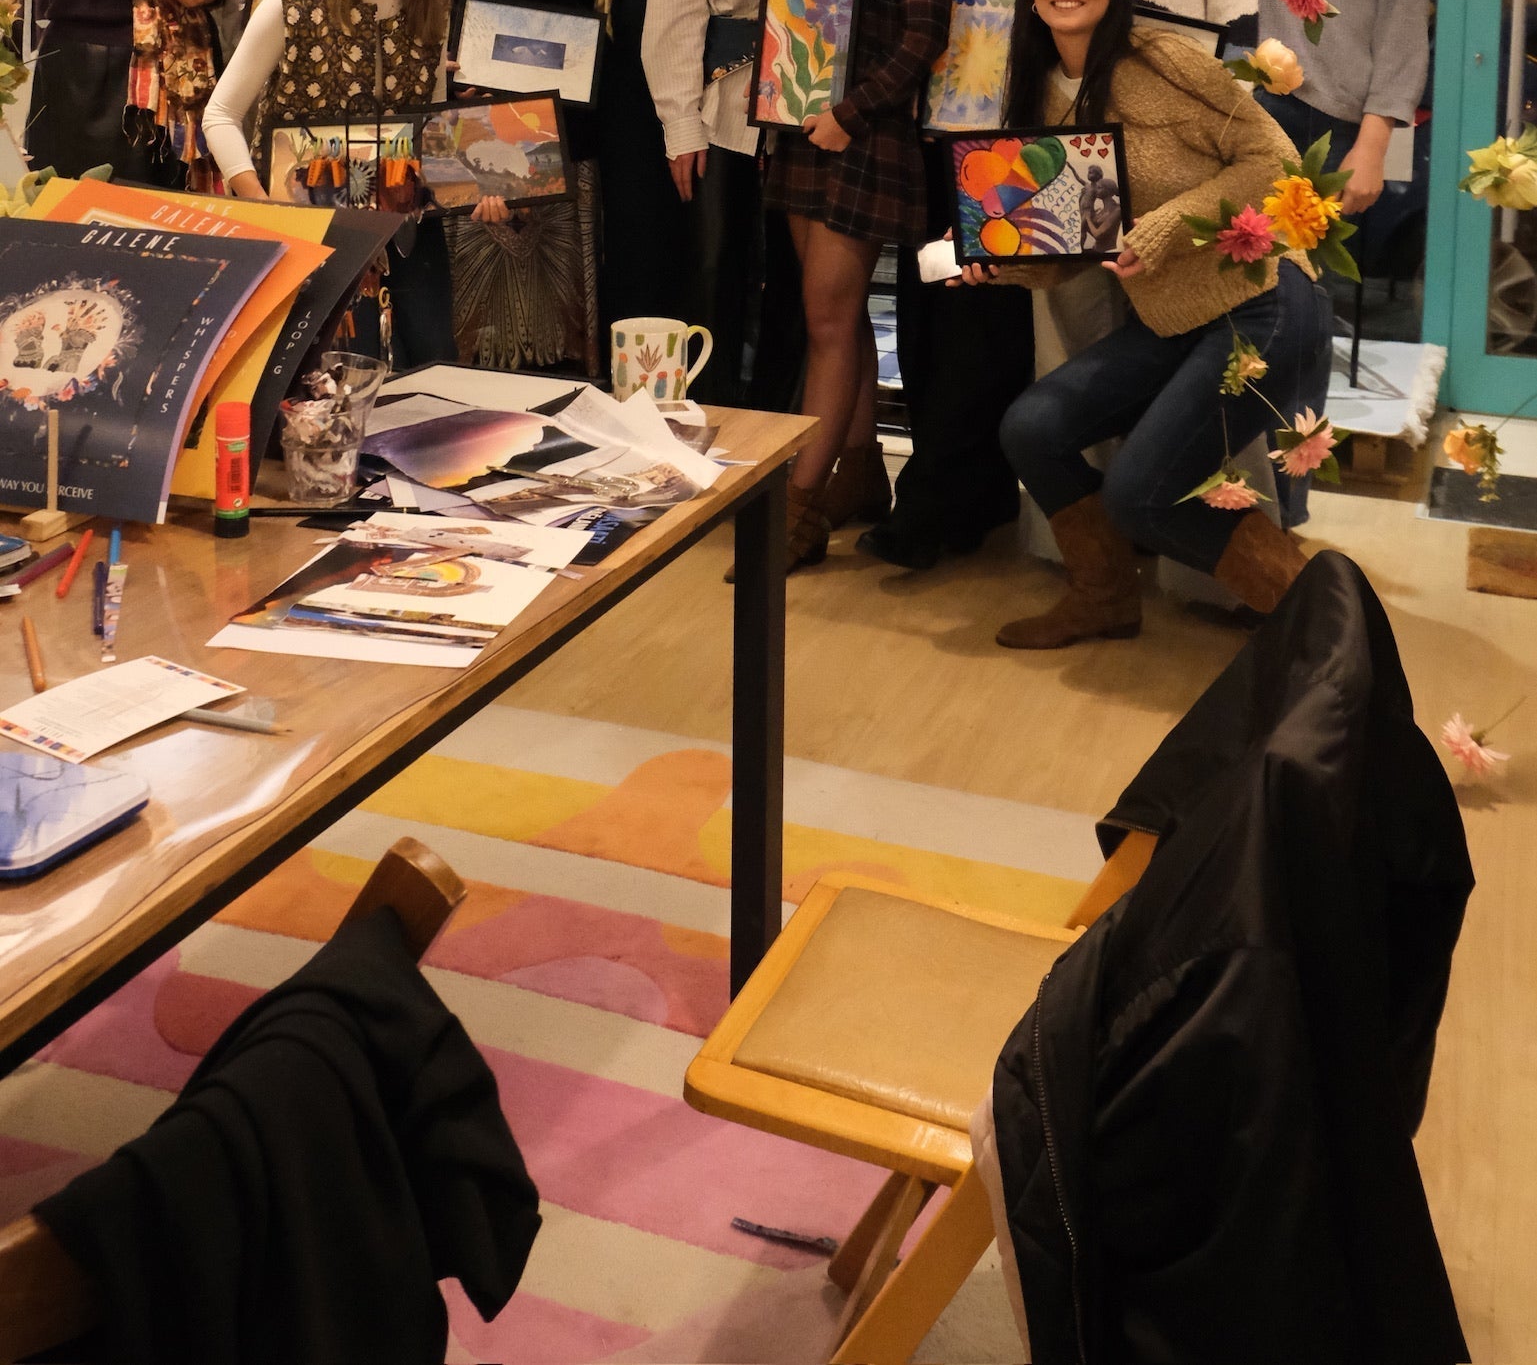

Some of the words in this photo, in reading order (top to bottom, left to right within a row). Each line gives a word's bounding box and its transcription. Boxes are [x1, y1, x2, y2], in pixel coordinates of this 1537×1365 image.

[151, 205, 241, 237] GALENE
[81, 229, 181, 252] GALENE
[160, 316, 214, 414] WHISPERS
[22, 481, 45, 494] YOU
[47, 484, 95, 500] RCEIVE
